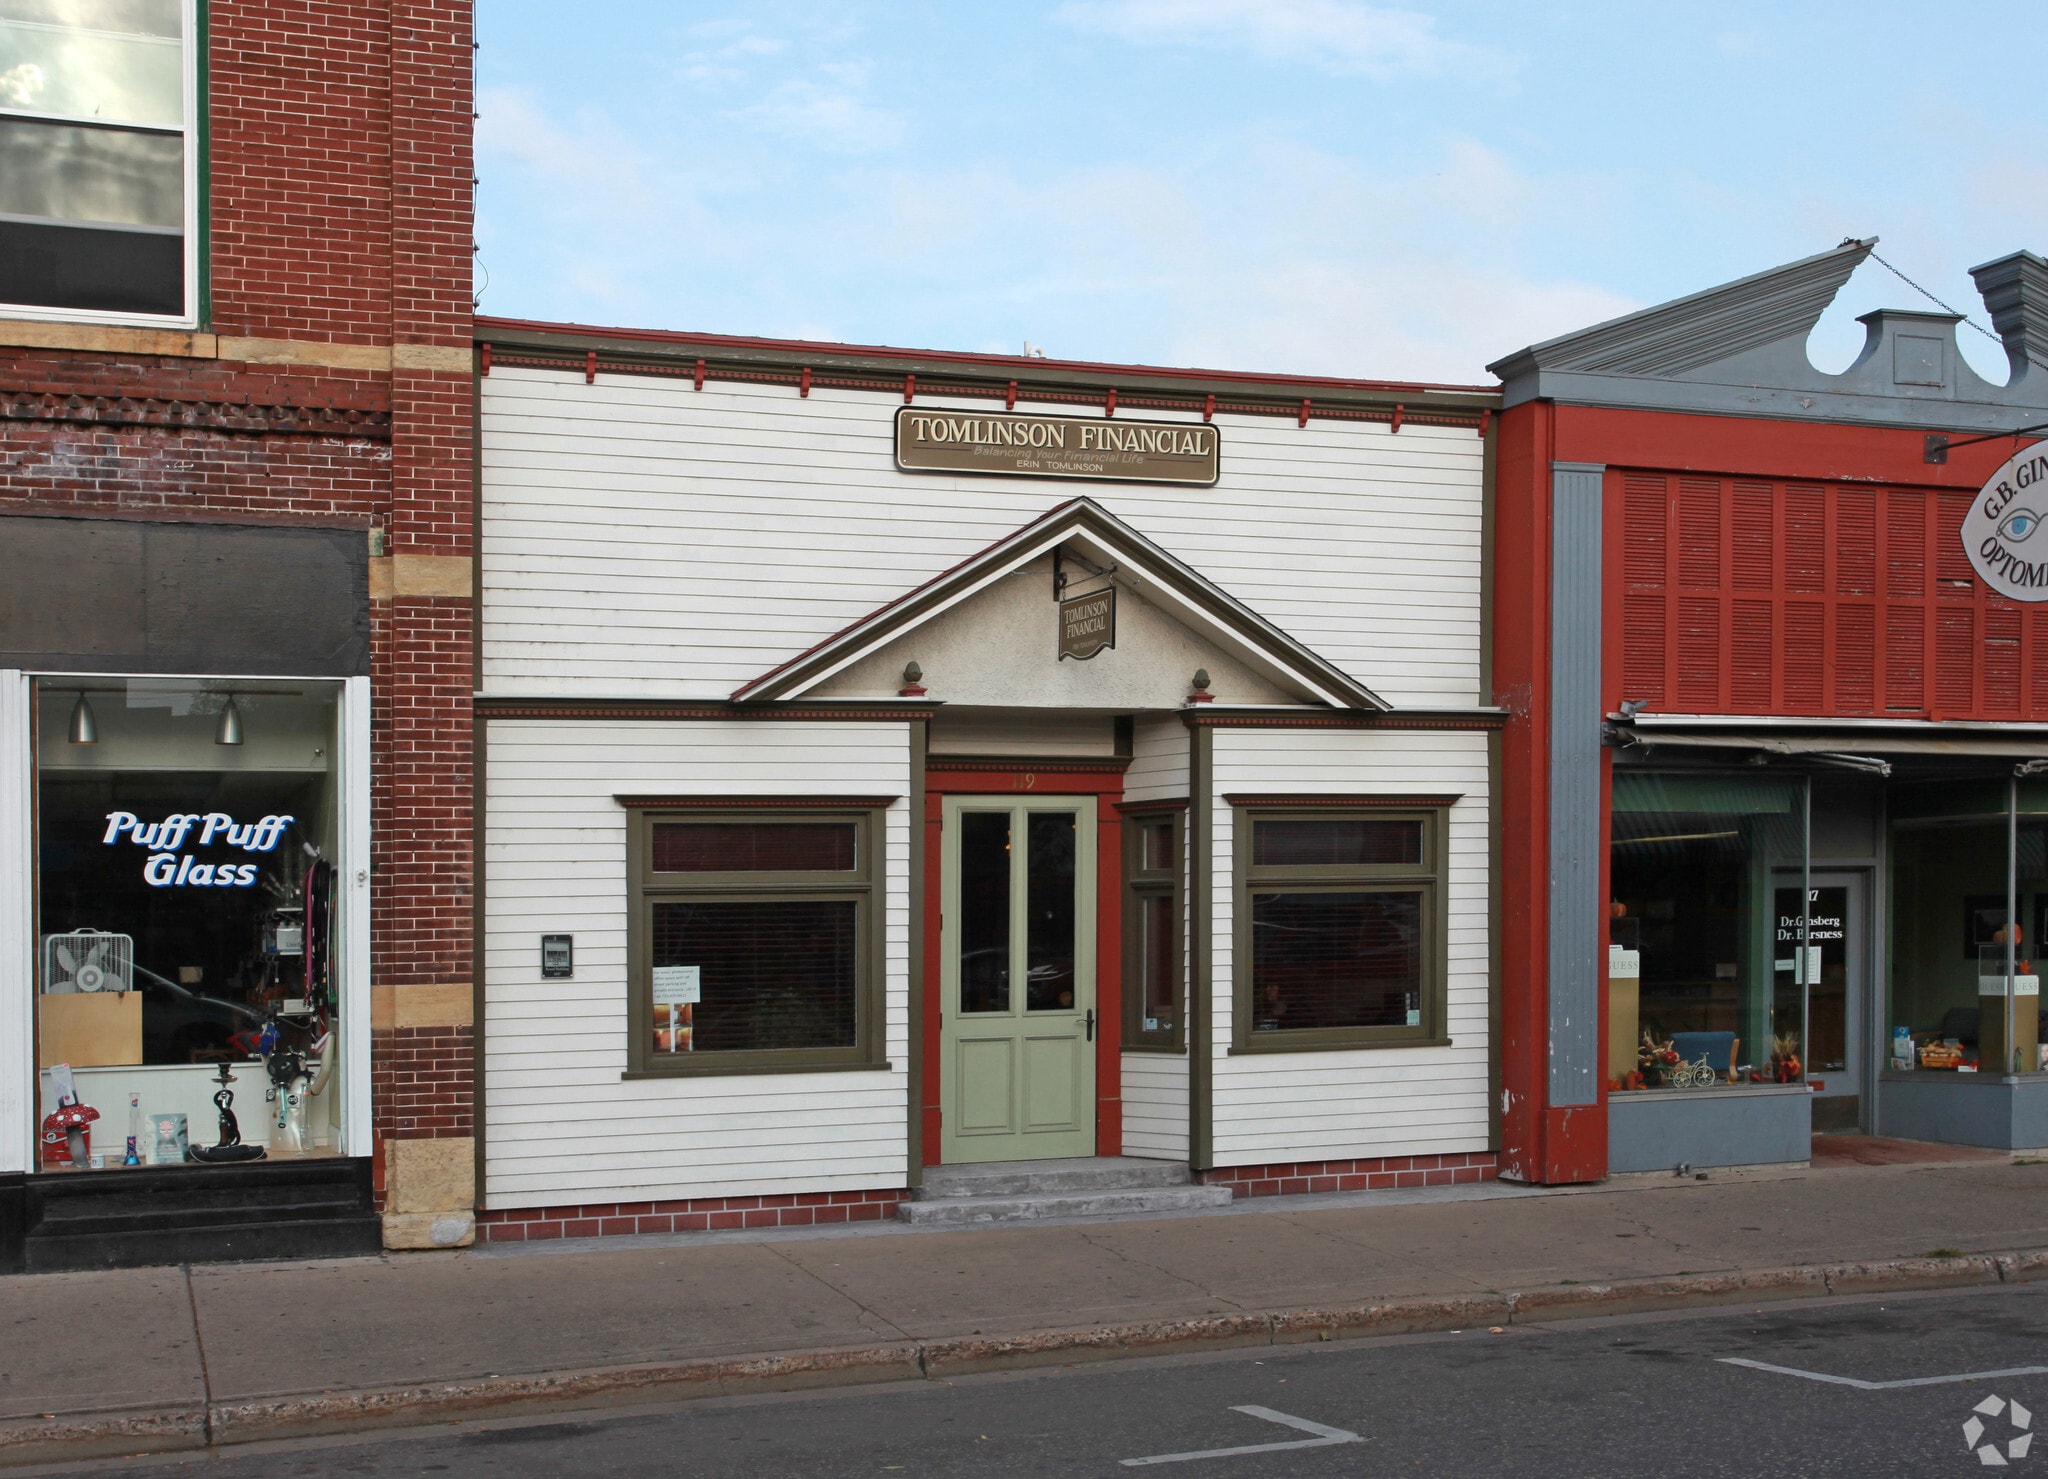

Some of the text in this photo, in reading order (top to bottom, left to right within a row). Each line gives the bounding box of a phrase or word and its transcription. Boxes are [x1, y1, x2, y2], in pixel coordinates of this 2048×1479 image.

[911, 417, 1211, 456] TOMLINSON FINANCIAL
[973, 446, 1144, 464] Balancing Your Financial Life
[1016, 459, 1103, 472] ERIN TOMLINSON
[1984, 481, 2018, 520] G.B.
[1980, 536, 2048, 588] OPTOM
[1064, 600, 1108, 624] TOMLINSON
[1067, 616, 1105, 638] FINANCIAL
[103, 811, 296, 853] Puff Puff
[143, 852, 260, 888] Glass
[1777, 928, 1843, 940] Dr. Brsness
